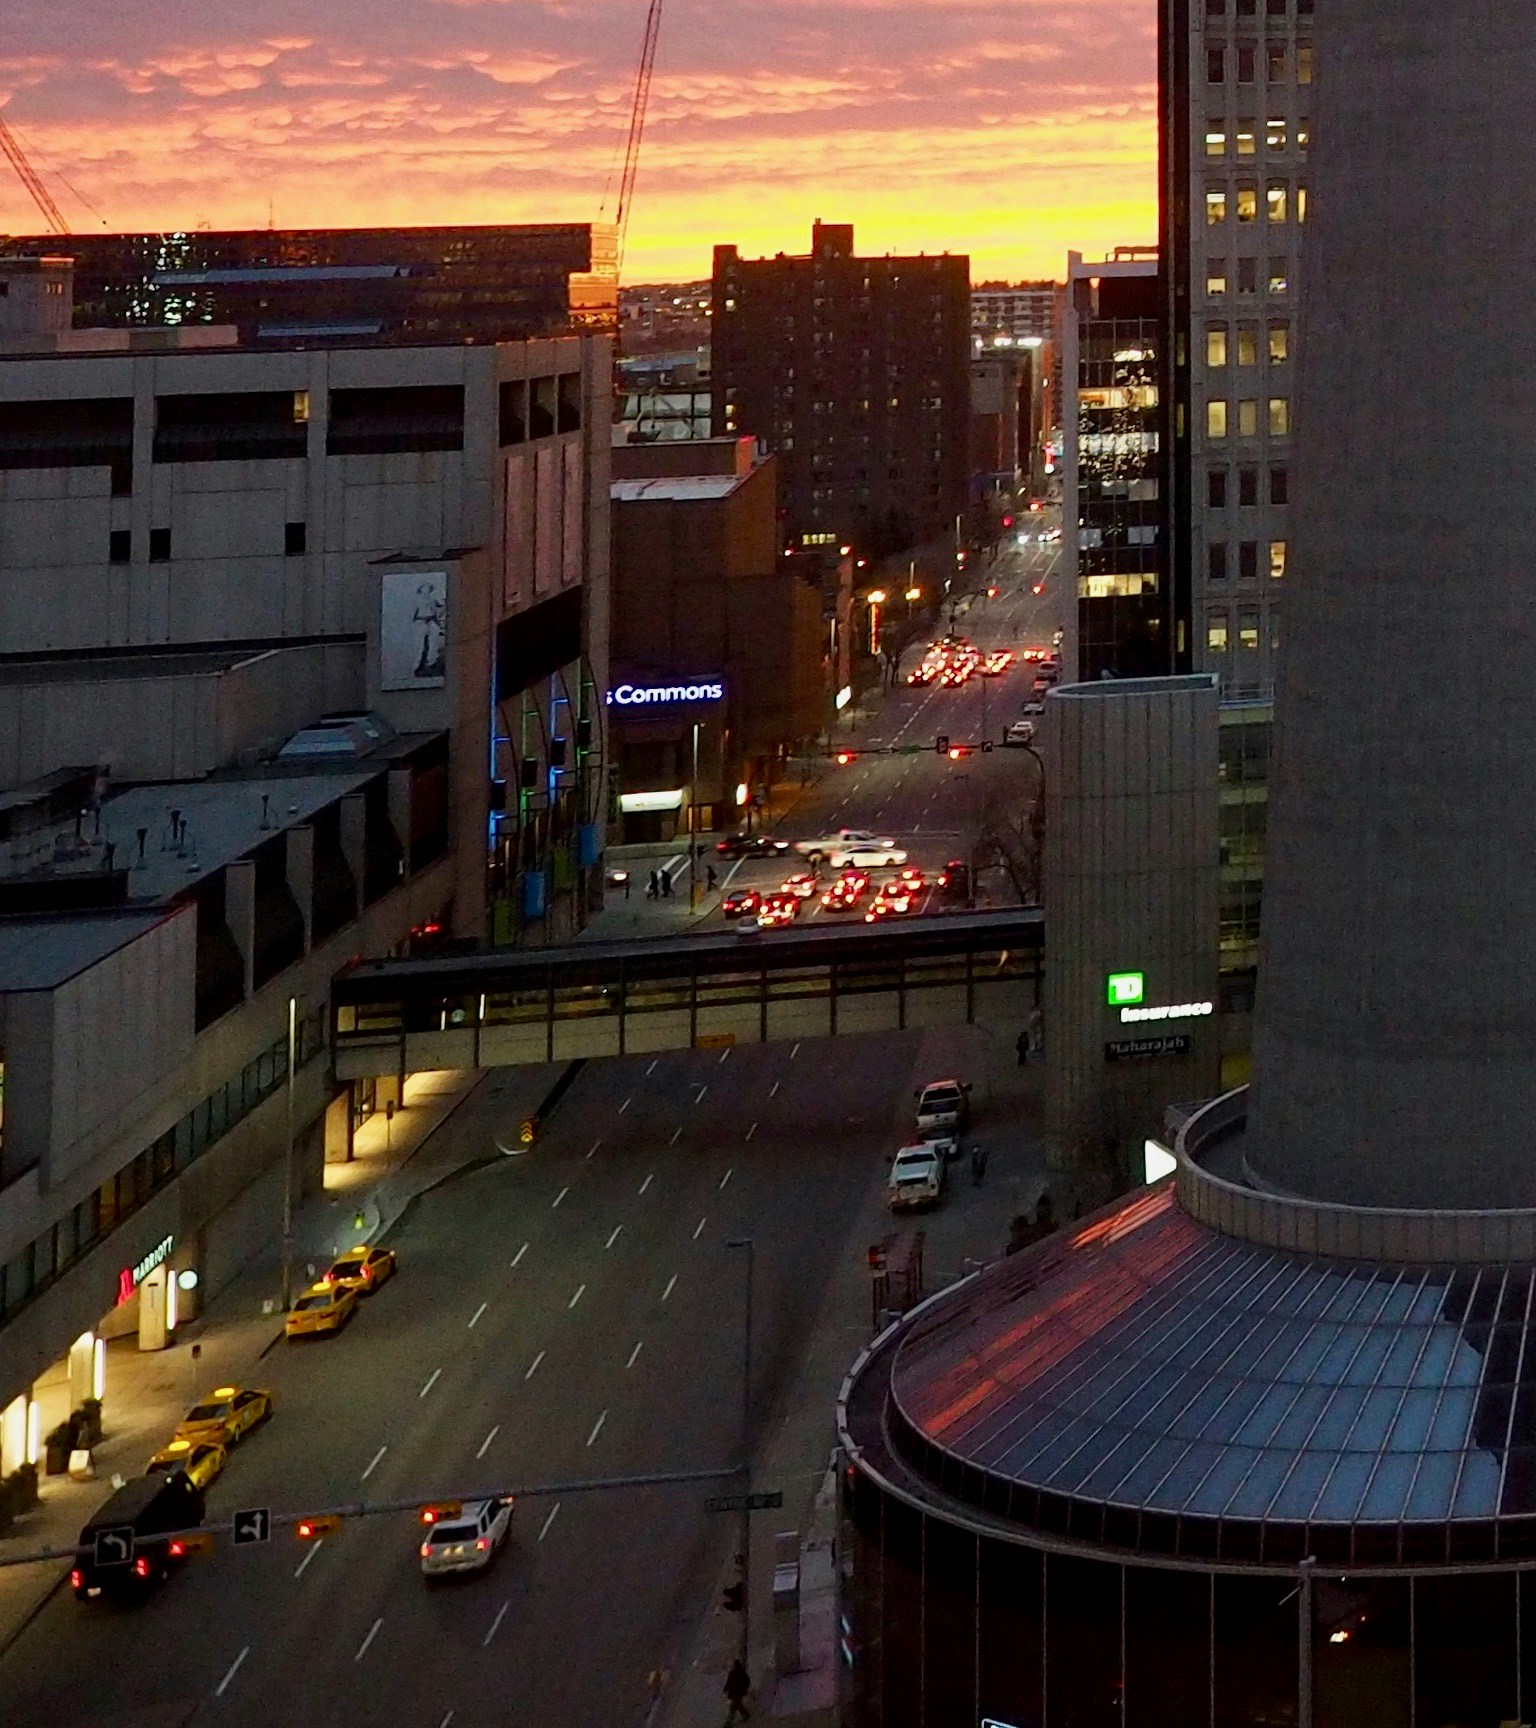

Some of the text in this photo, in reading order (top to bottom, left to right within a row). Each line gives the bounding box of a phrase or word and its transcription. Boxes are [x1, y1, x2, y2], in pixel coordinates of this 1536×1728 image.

[615, 684, 723, 704] Commons
[1109, 975, 1143, 1002] TD
[1121, 1002, 1213, 1023] Insurance
[133, 1236, 173, 1286] MARRIOTT
